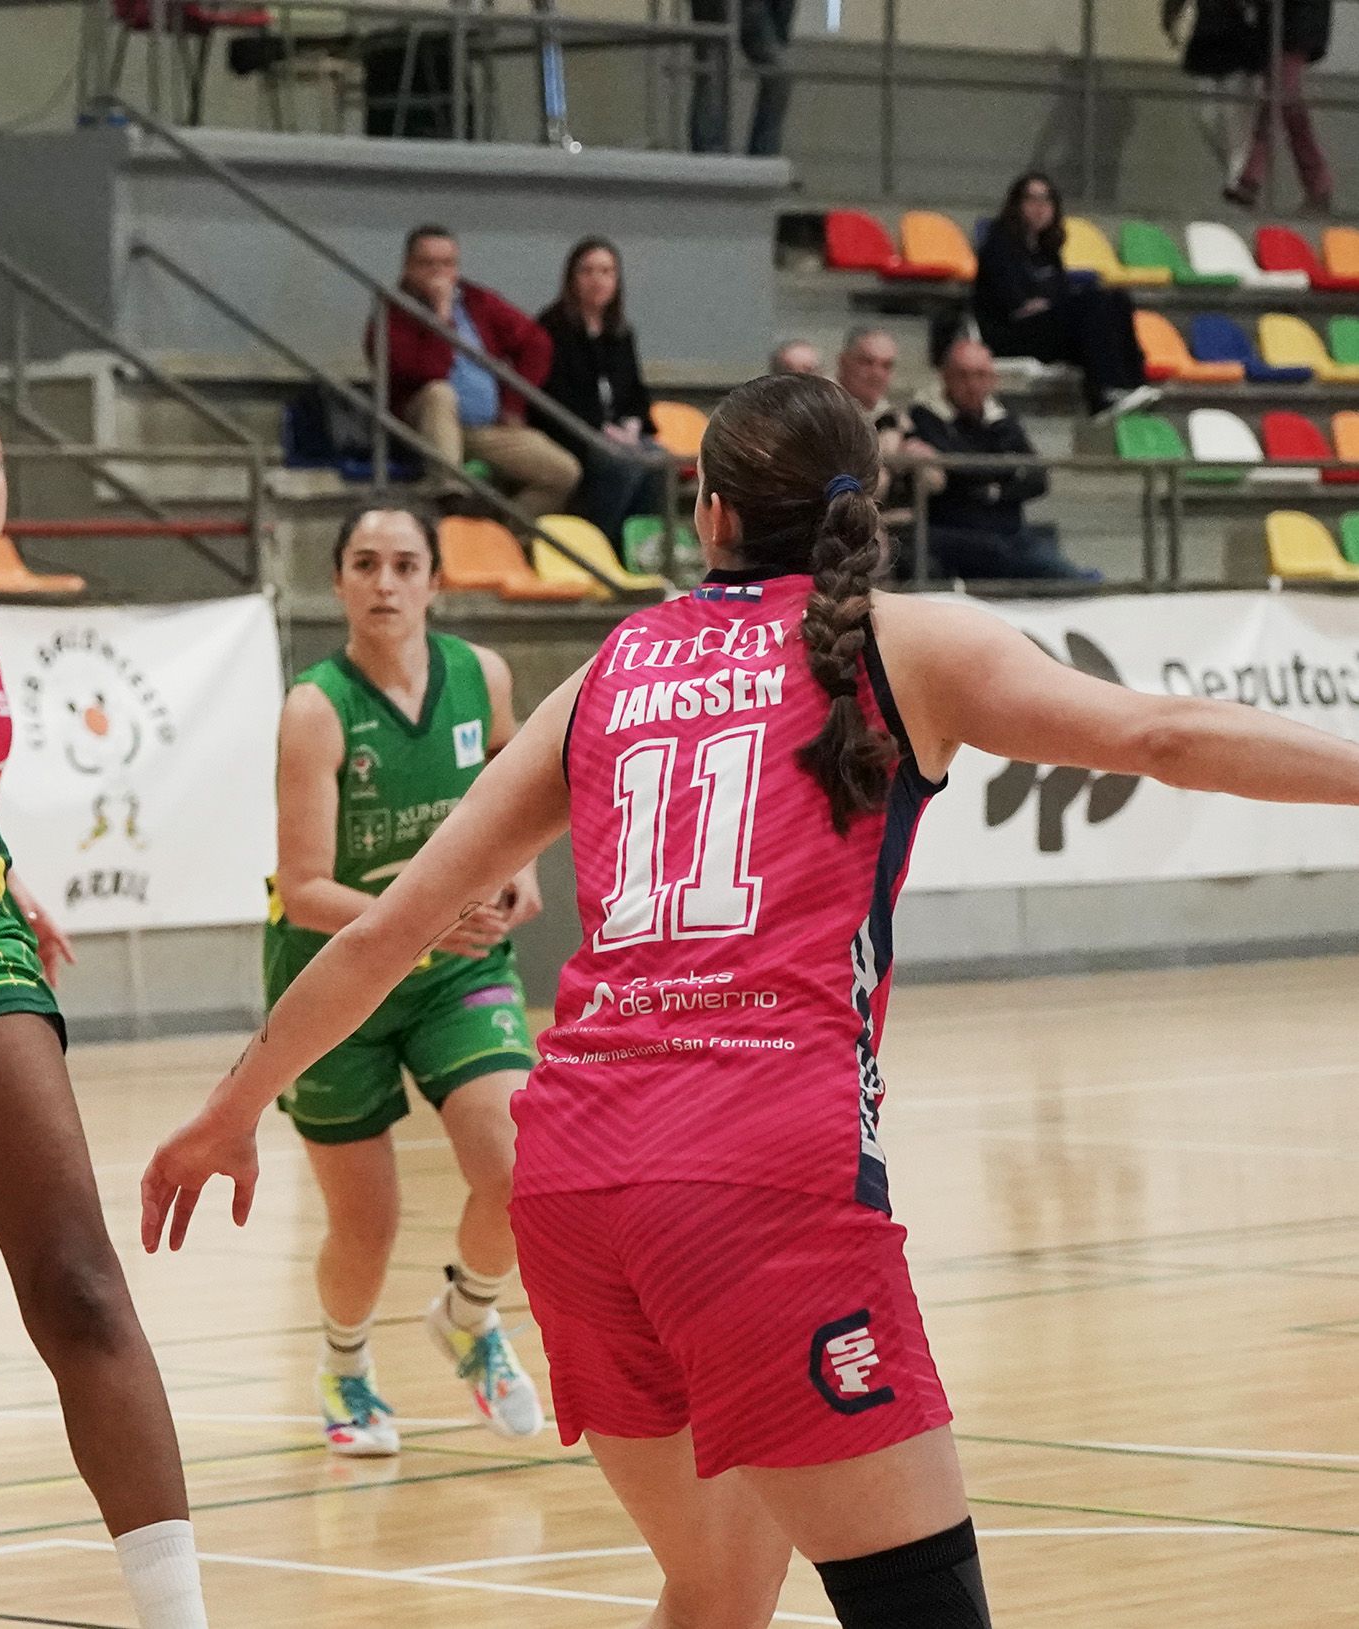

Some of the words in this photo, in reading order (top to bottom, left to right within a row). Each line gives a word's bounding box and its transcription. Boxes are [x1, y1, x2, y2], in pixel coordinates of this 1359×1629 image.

[605, 664, 786, 735] JANSSEN
[593, 723, 767, 953] 11
[619, 990, 654, 1017] de
[659, 985, 778, 1013] Invierno
[581, 1039, 671, 1065] Internacional
[671, 1037, 703, 1052] San
[708, 1037, 796, 1051] Fernando
